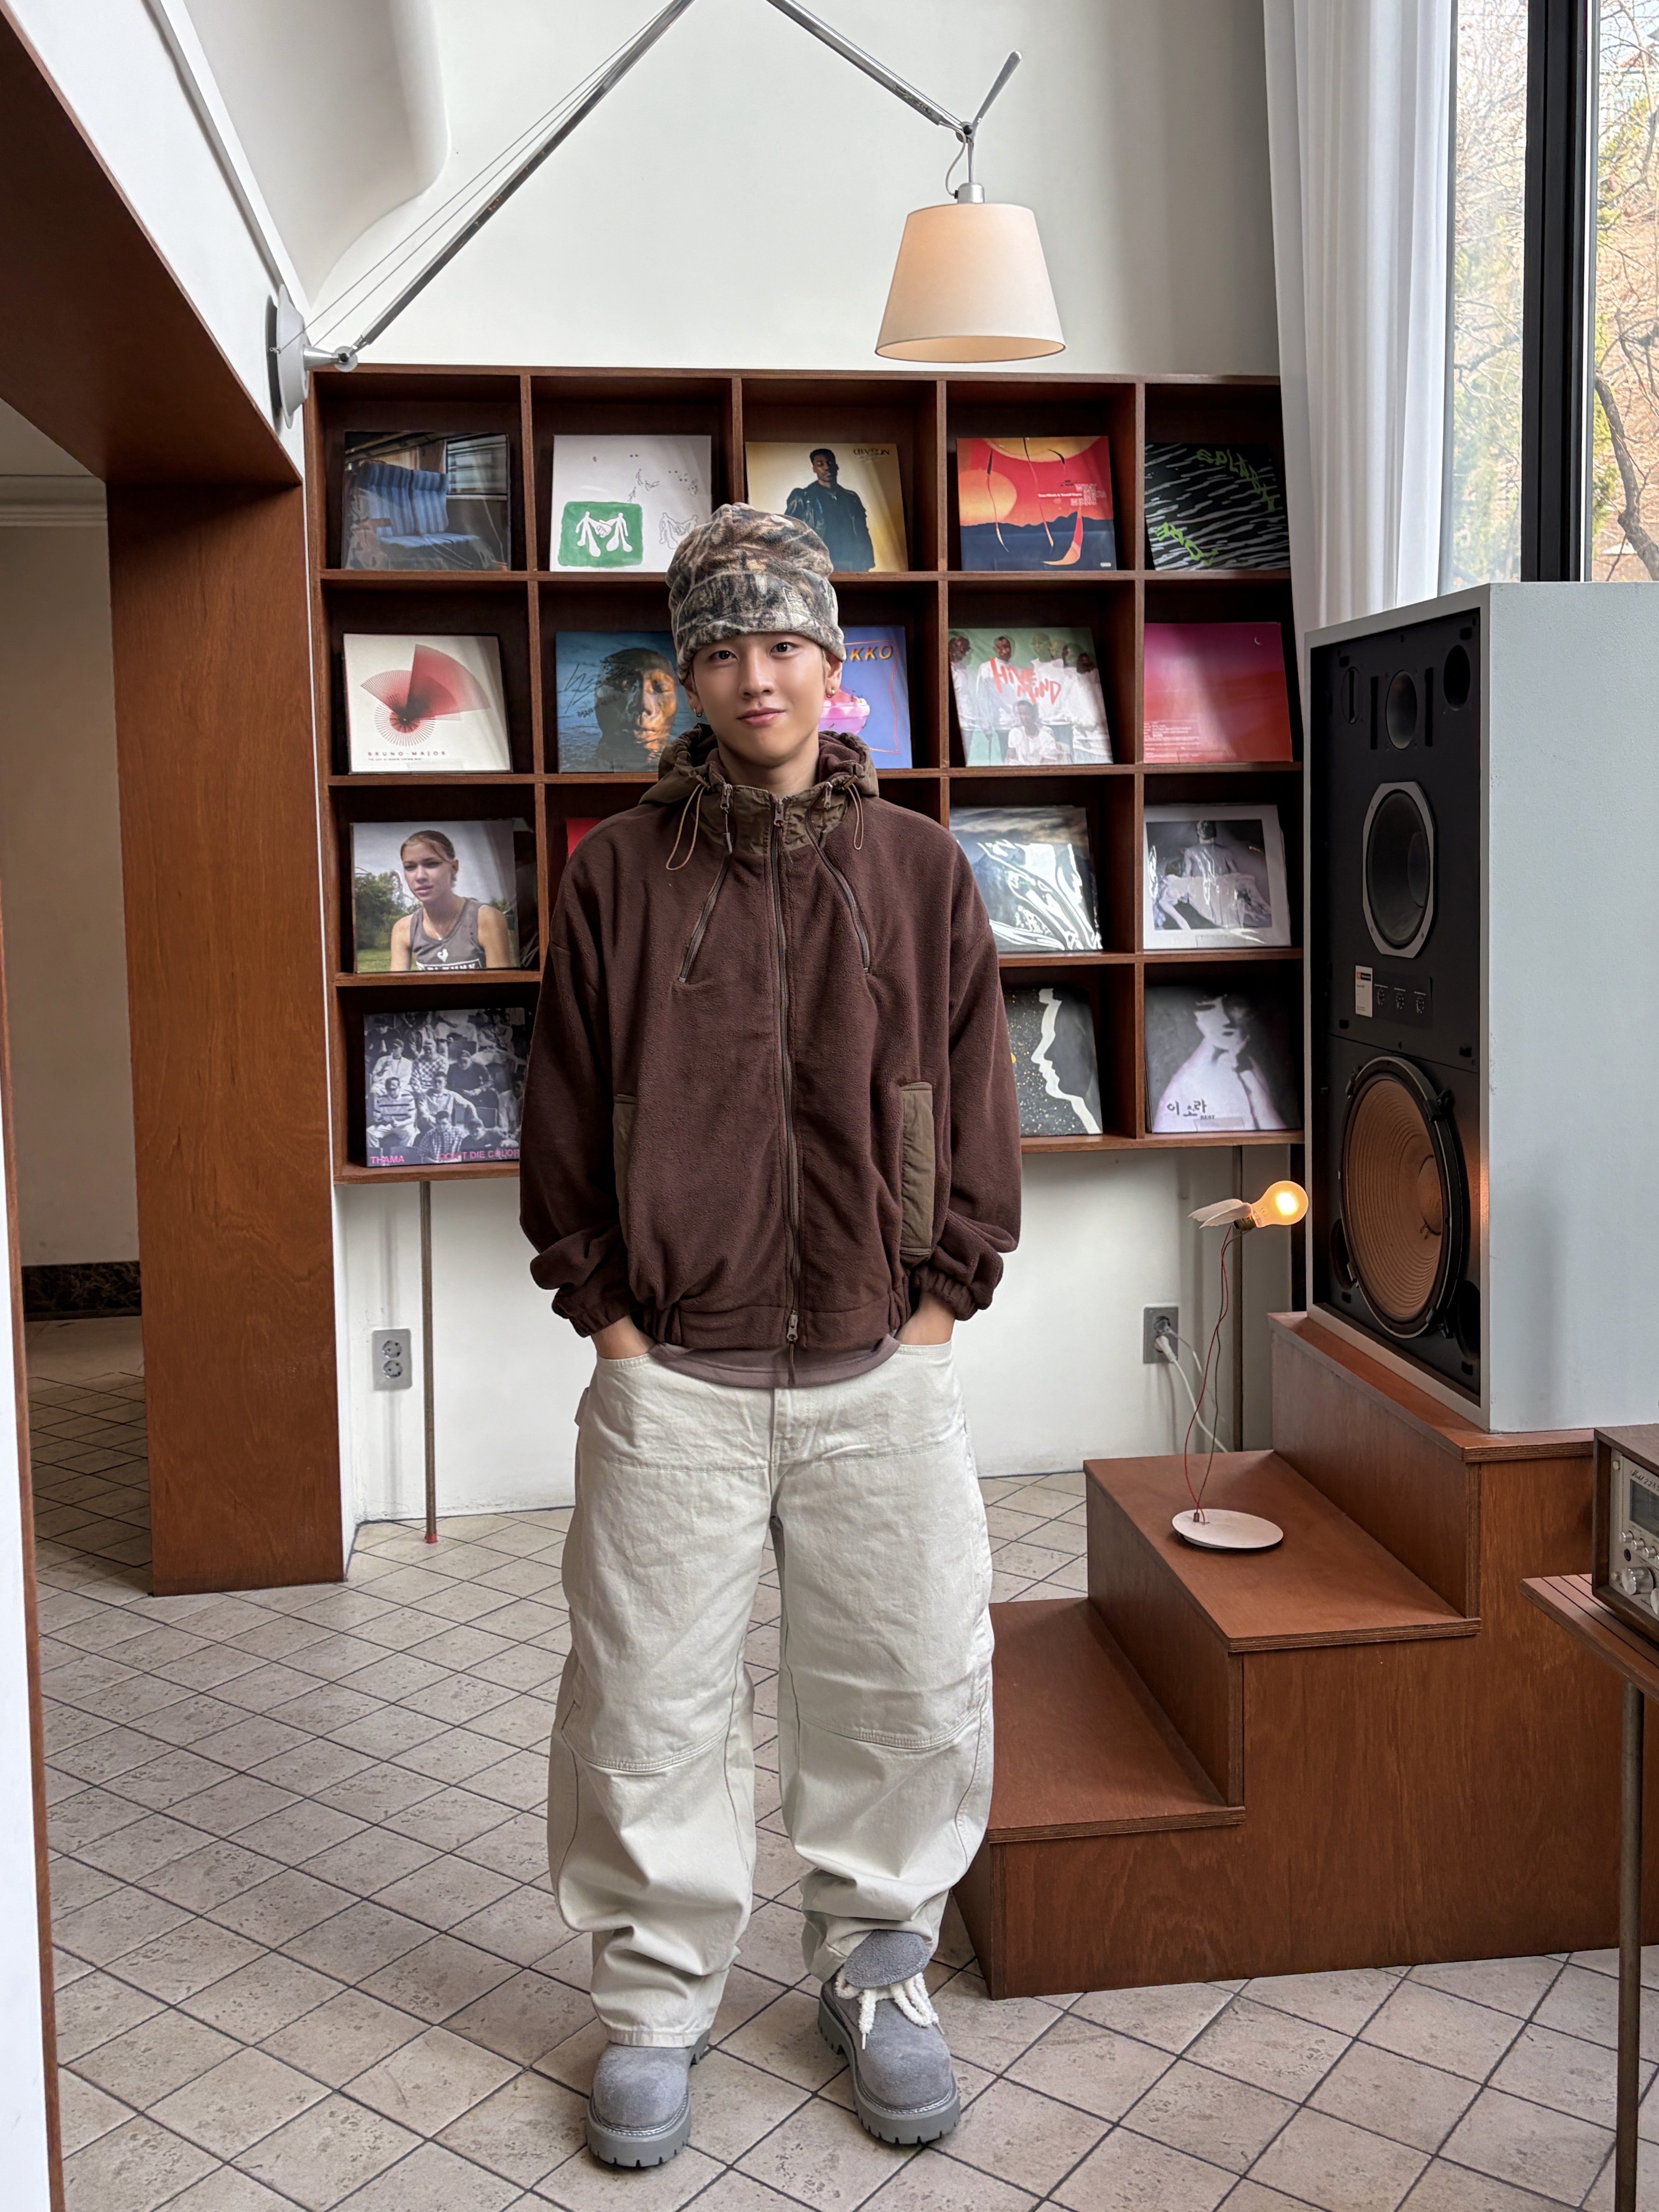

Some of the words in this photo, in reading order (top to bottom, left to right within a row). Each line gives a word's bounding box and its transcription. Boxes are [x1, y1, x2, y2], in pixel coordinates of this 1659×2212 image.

[845, 645, 893, 661] KKO
[370, 1155, 405, 1163] THAMA
[469, 1150, 485, 1159] DIE
